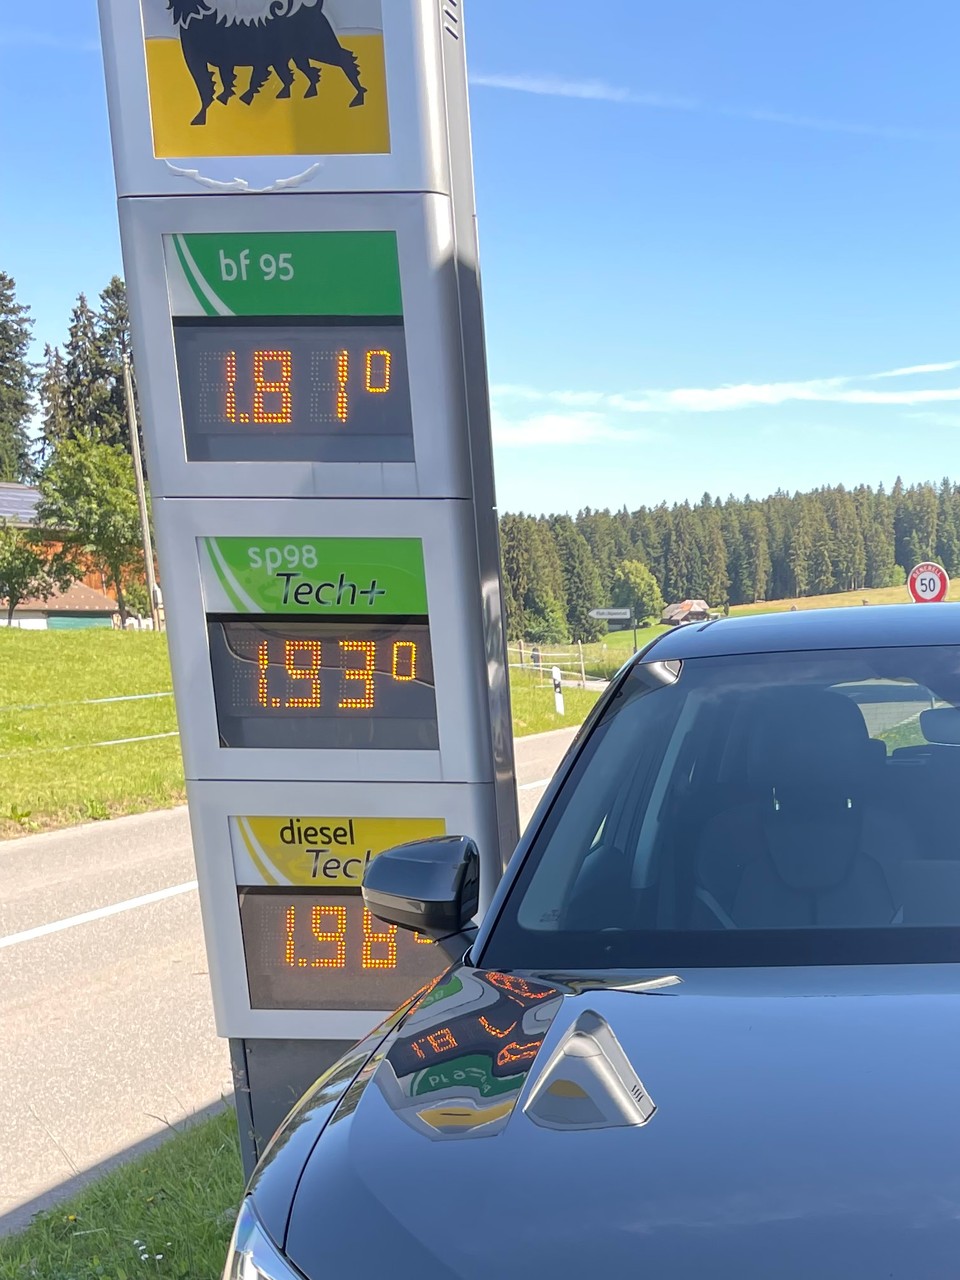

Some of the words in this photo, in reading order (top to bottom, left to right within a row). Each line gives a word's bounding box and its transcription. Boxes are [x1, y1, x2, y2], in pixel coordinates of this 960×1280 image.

[219, 249, 251, 281] bf
[260, 252, 295, 281] 95
[247, 544, 318, 576] sp98
[275, 572, 386, 606] Tech+
[920, 578, 936, 592] 50
[279, 818, 355, 845] diesel
[305, 849, 371, 879] Tec
